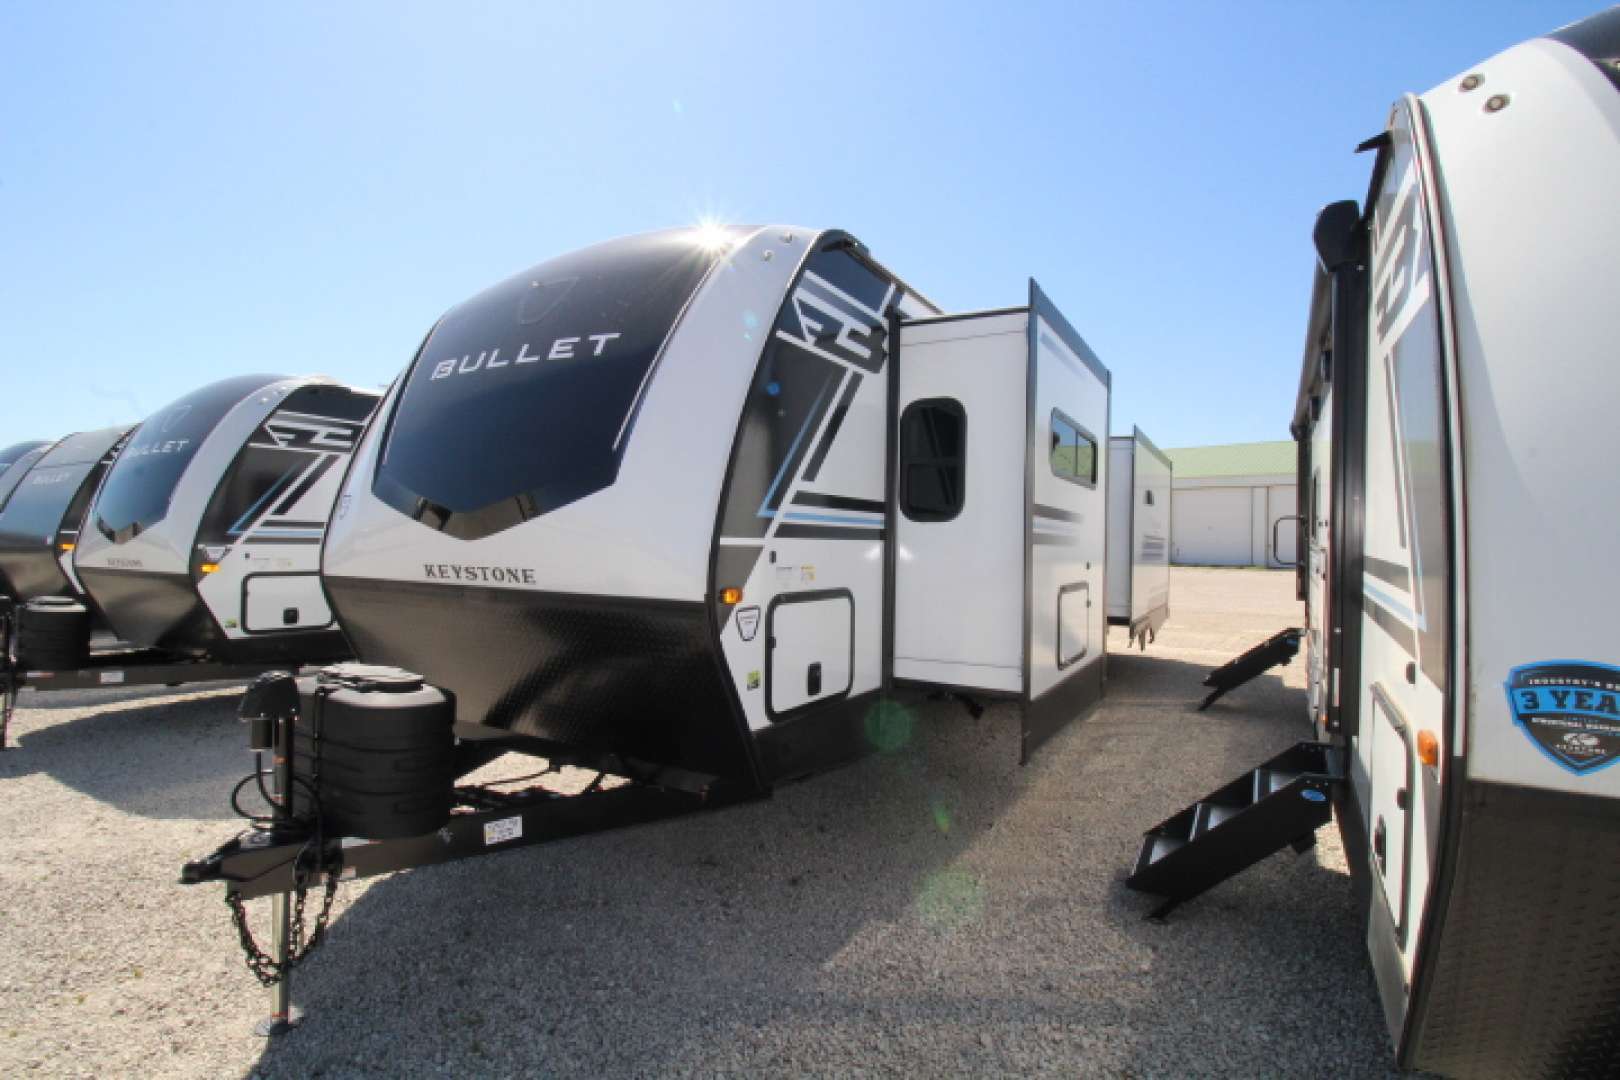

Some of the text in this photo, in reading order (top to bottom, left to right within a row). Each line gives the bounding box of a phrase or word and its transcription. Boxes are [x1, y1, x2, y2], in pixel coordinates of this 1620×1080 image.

[430, 332, 622, 380] BULLET
[424, 563, 537, 586] KEYSTONE
[1519, 690, 1540, 710] 3
